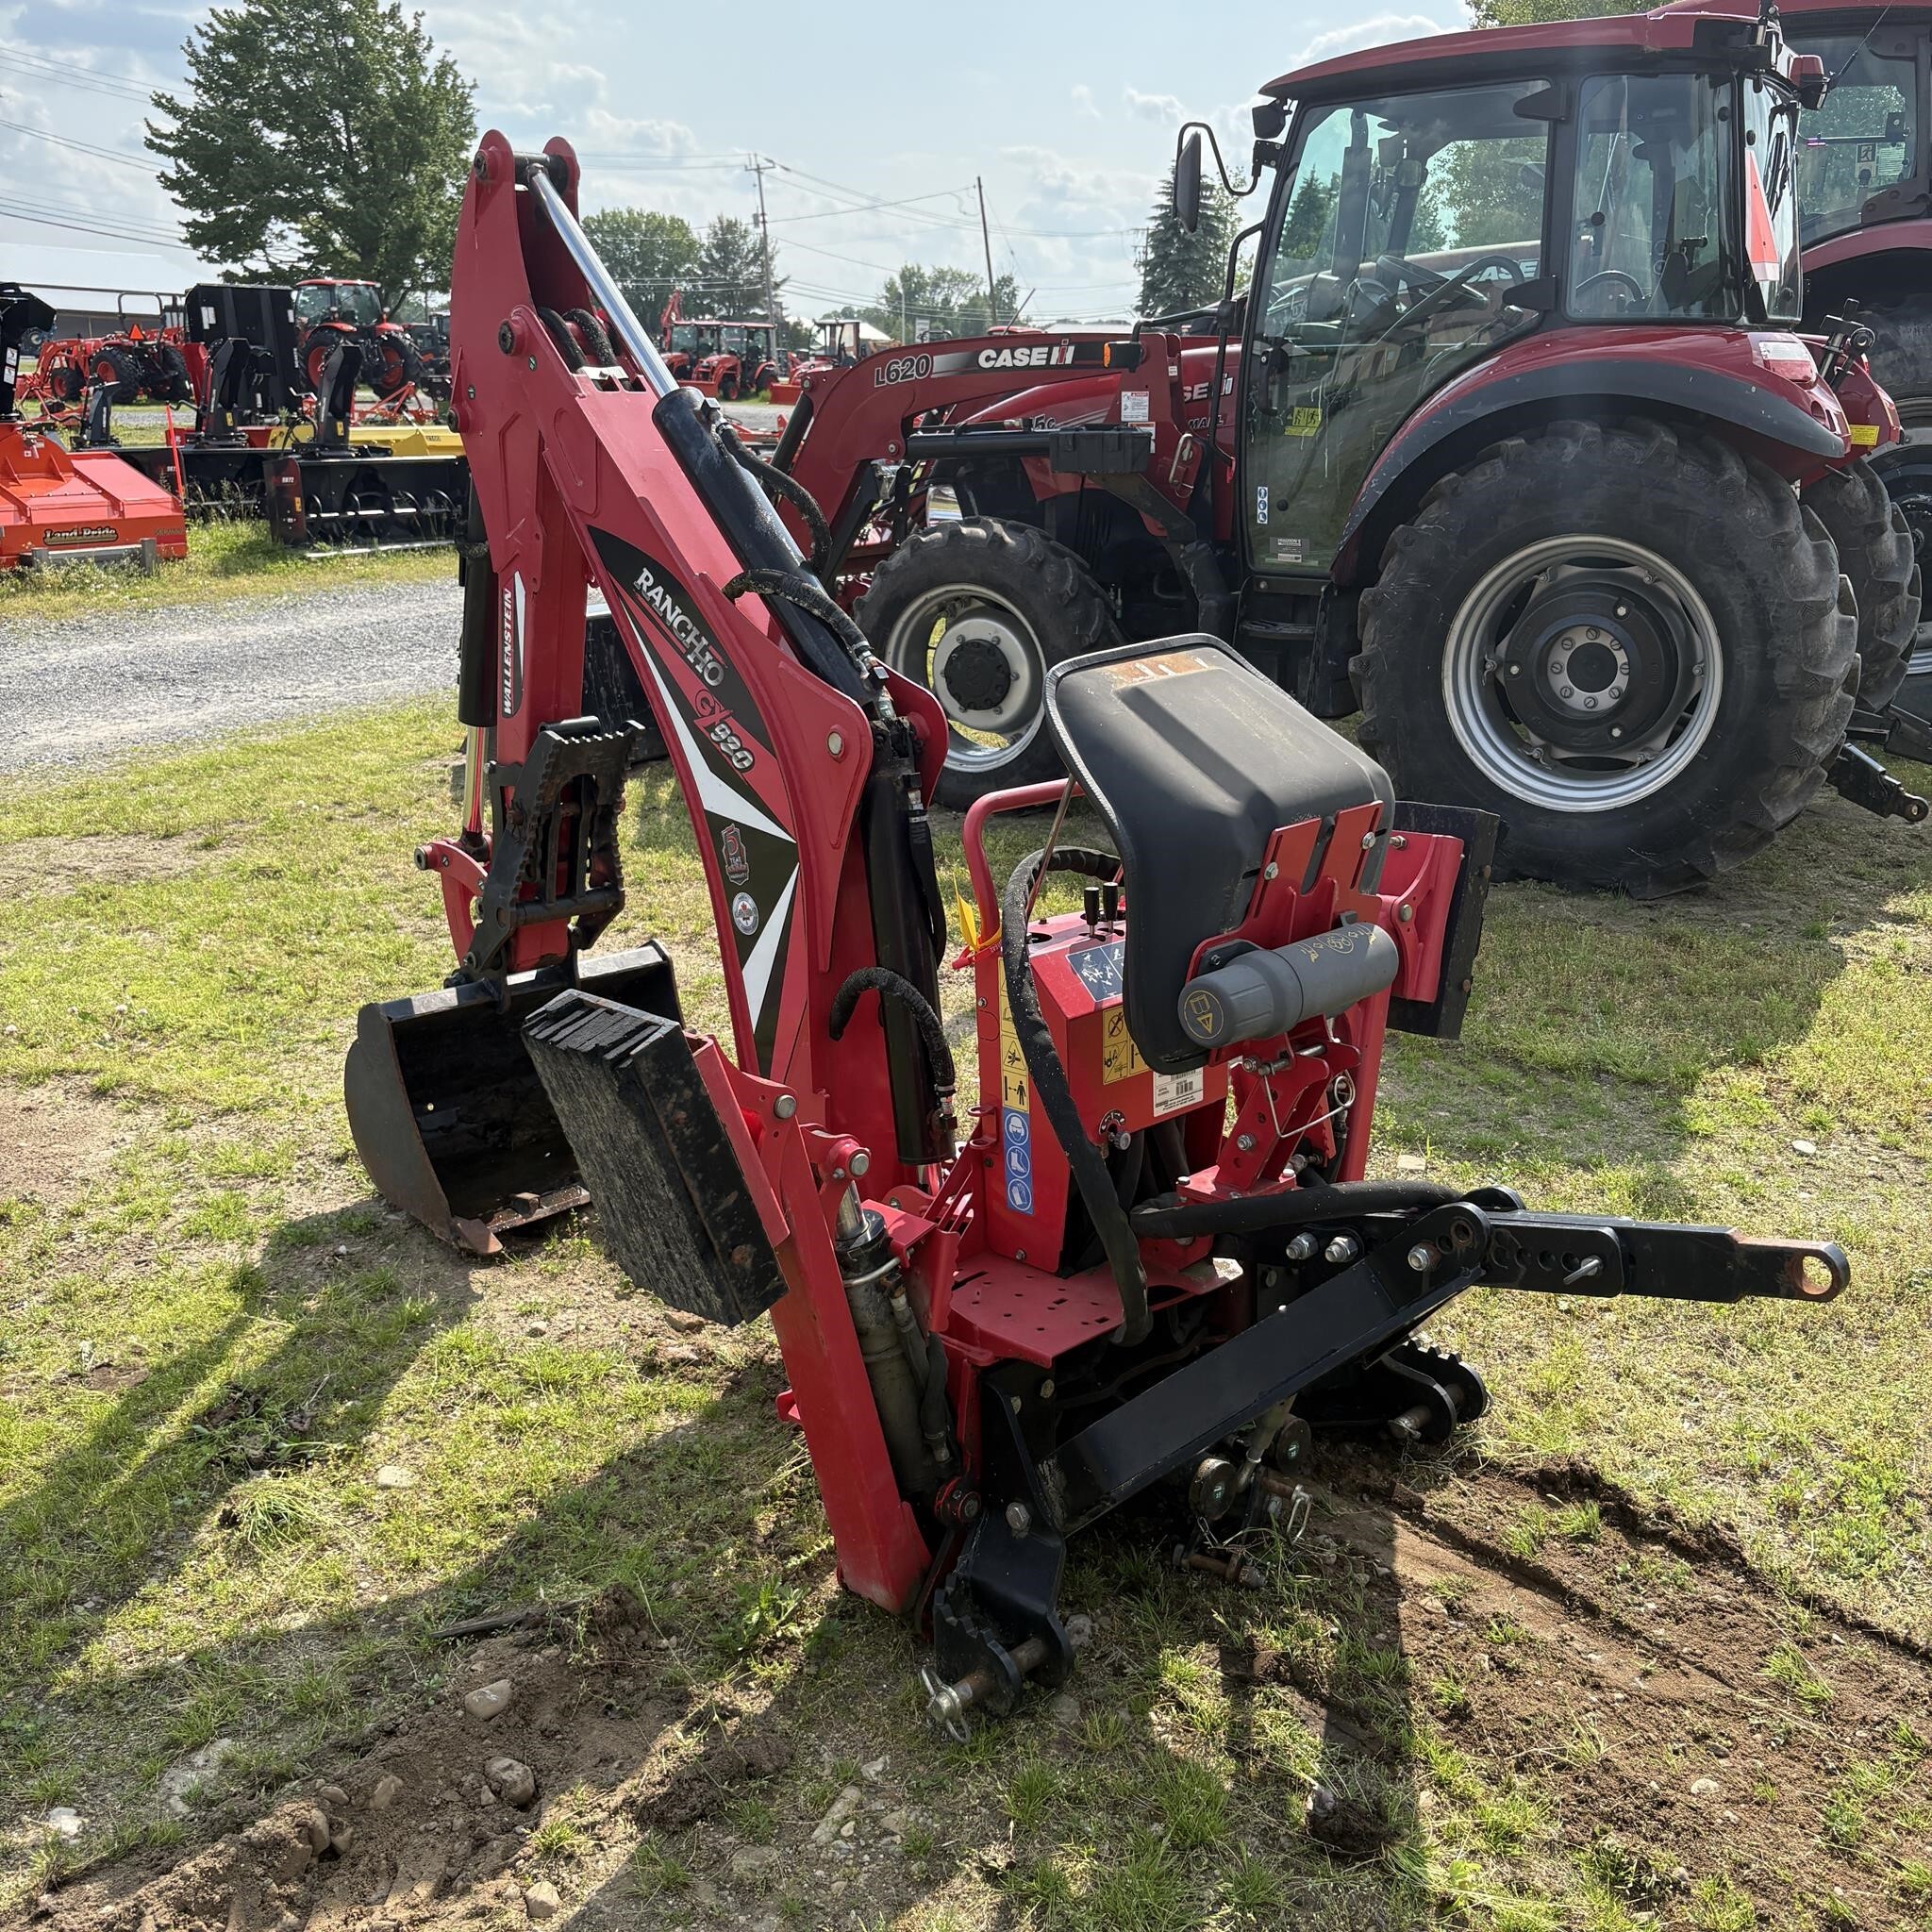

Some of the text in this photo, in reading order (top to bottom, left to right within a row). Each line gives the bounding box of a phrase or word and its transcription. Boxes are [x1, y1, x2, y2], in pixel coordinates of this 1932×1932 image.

[874, 354, 933, 388] L620
[977, 347, 1048, 368] CASE
[503, 588, 513, 714] WALLENSTEIN
[633, 567, 724, 687] RANCHO
